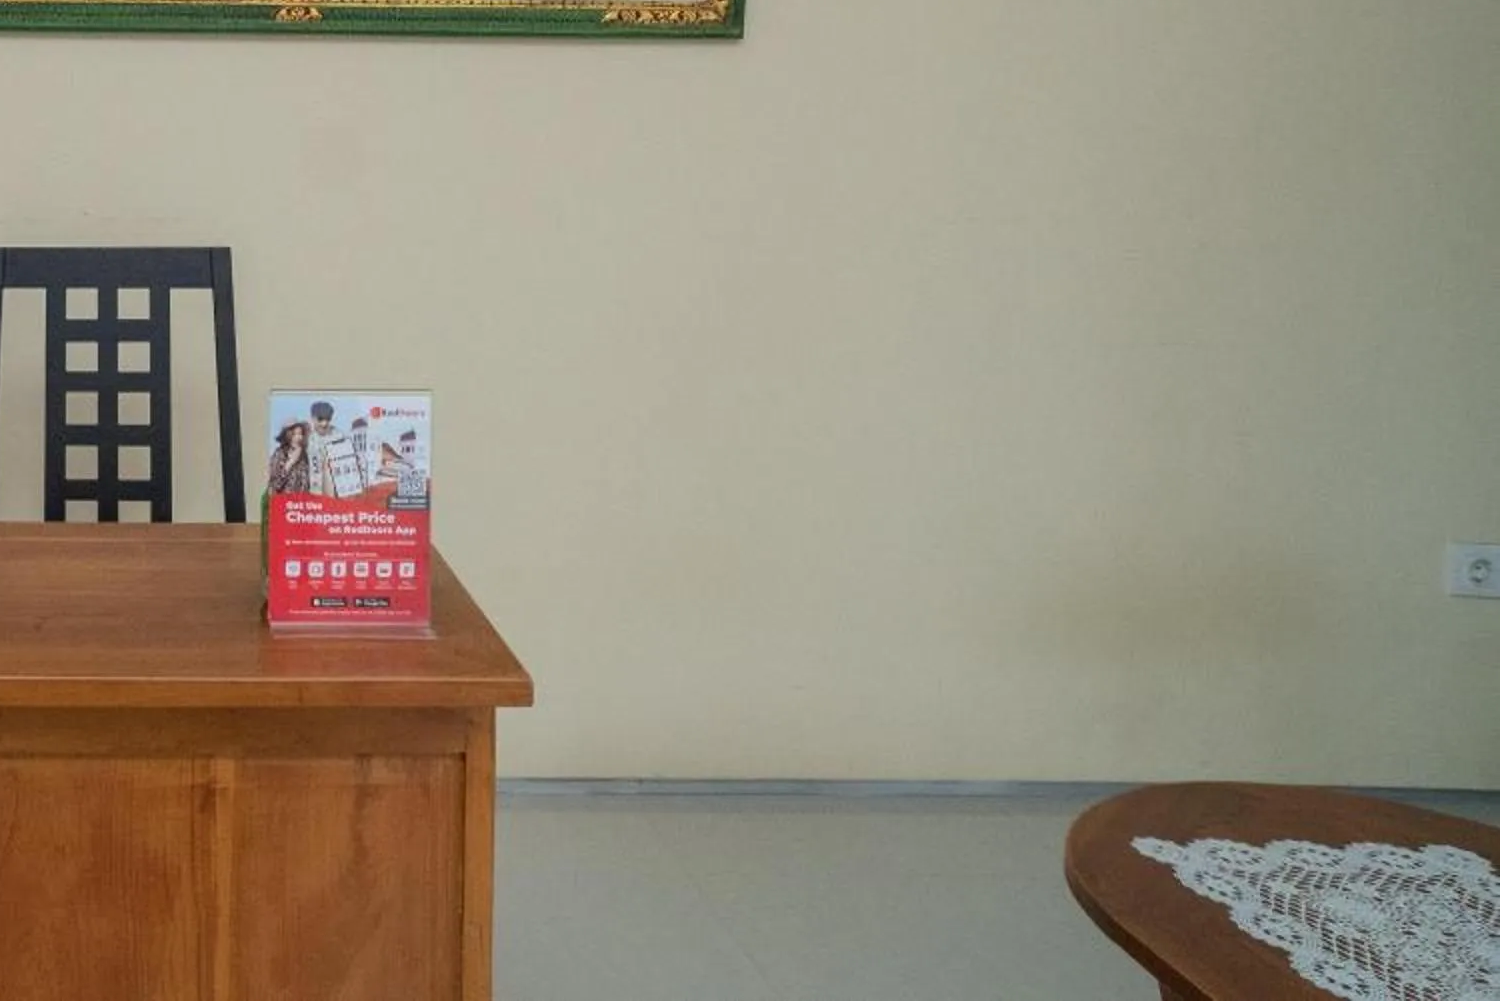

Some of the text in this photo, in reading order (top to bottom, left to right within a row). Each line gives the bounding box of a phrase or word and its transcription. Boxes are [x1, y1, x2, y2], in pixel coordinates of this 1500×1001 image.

[285, 510, 396, 525] Cheapest Price
[395, 525, 418, 536] App
